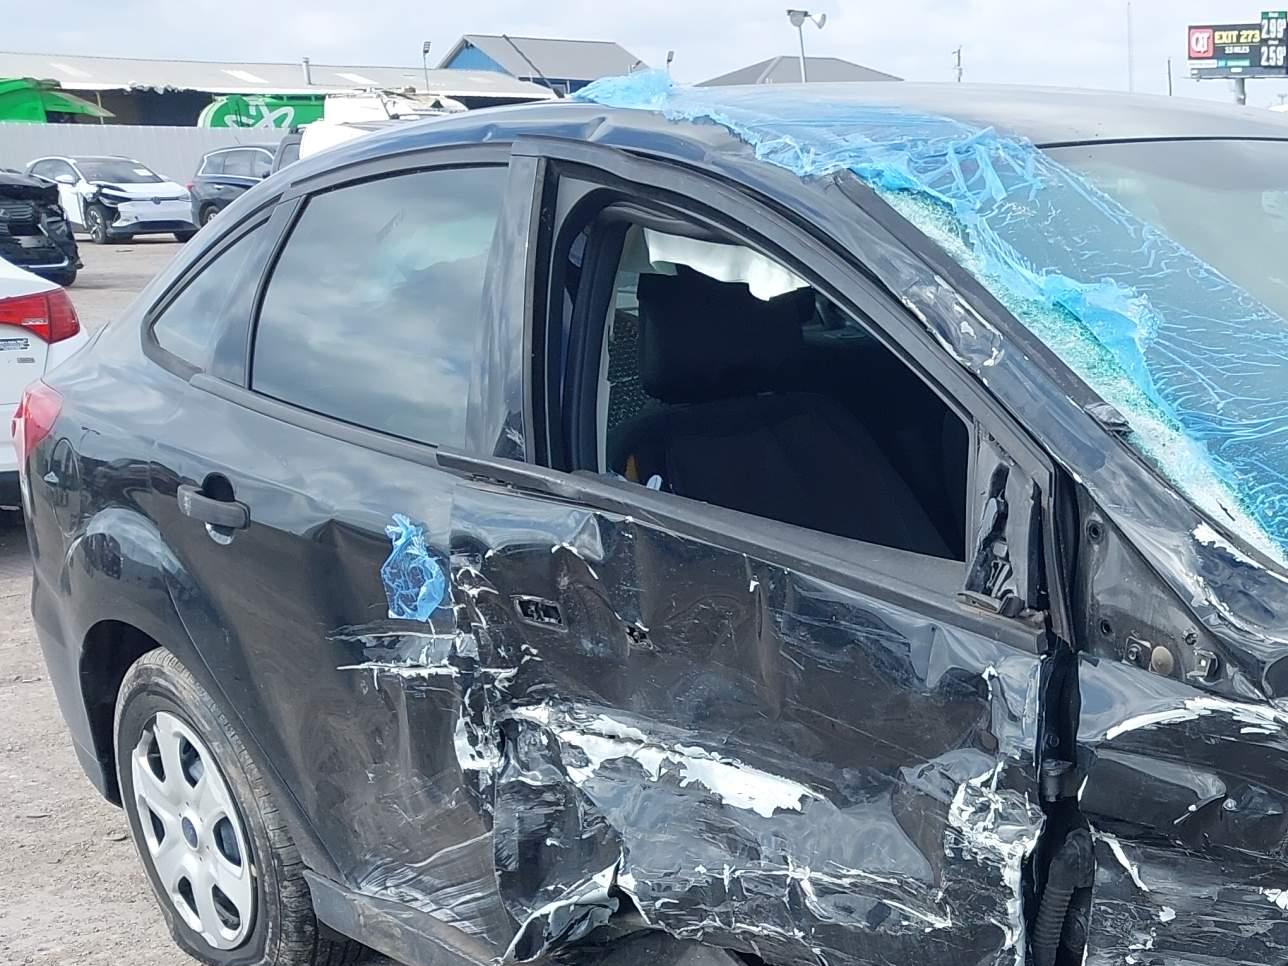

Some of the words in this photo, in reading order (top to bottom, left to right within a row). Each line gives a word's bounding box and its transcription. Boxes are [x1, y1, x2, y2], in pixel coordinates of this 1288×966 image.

[1192, 32, 1210, 52] QT
[1214, 31, 1238, 43] EXIT
[1240, 30, 1260, 43] 273
